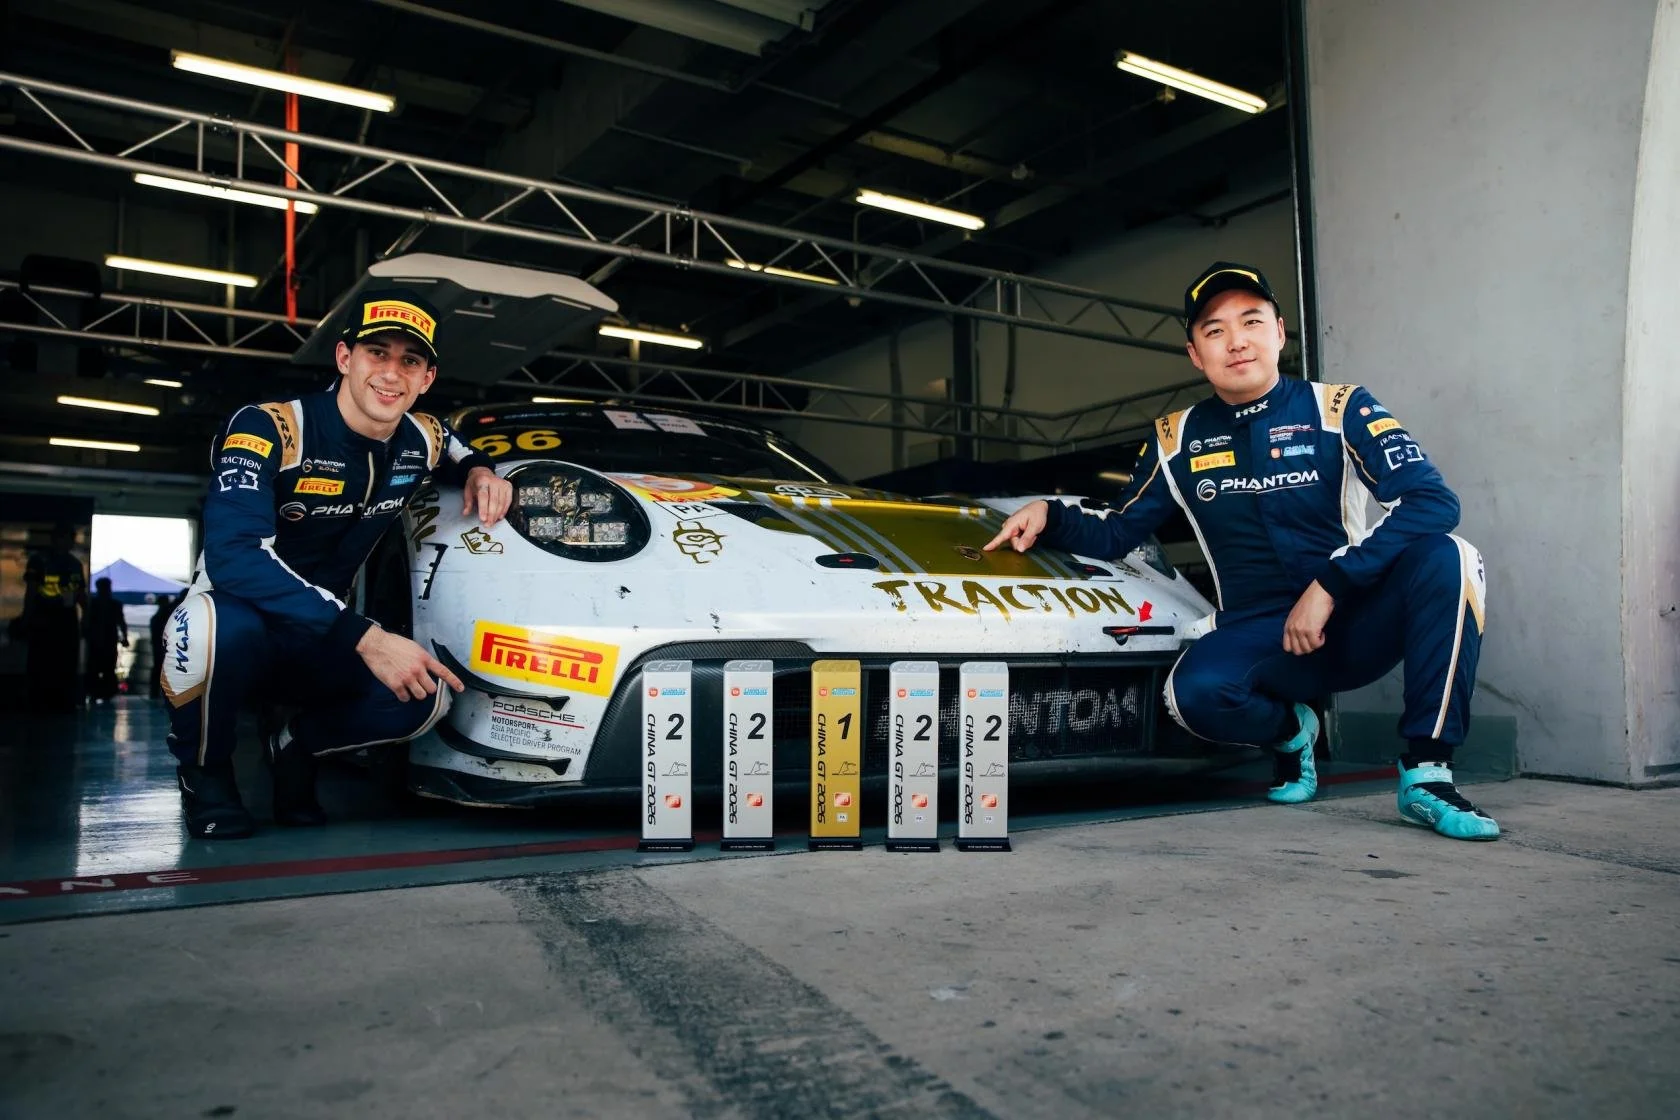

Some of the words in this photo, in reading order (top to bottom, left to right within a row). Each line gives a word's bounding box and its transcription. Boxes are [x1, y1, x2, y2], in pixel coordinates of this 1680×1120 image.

[370, 304, 431, 334] PIRELLI
[1235, 400, 1269, 418] HRX
[225, 437, 267, 452] PIRELLI
[314, 459, 345, 468] PHANTOM
[300, 480, 339, 492] PIRELLI
[1220, 470, 1319, 491] PHANTOM
[872, 579, 1136, 624] TRACTION
[480, 632, 603, 683] PIRELLI
[491, 716, 536, 730] MOTORSPORT
[492, 701, 576, 723] PORSCHE
[490, 724, 505, 733] ASIA
[506, 727, 531, 738] PACIFIC
[647, 713, 656, 757] CHINA
[665, 713, 685, 741] 2
[729, 712, 738, 756] CHINA
[747, 712, 767, 740] 2
[817, 713, 826, 757] CHINA
[837, 713, 853, 740] 1
[895, 714, 904, 758] CHINA
[913, 714, 933, 741] 2
[965, 714, 975, 758] CHINA
[983, 714, 1003, 741] 2
[490, 732, 521, 744] SELECTED
[522, 737, 546, 749] DRIVER
[547, 743, 581, 756] PROGRAM
[647, 761, 656, 782] GT
[729, 761, 738, 782] GT
[817, 760, 826, 781] GT
[894, 761, 904, 782] GT
[965, 761, 974, 782] GT
[647, 784, 656, 825] 2026
[729, 783, 738, 825] 2026
[817, 783, 826, 825] 2026
[894, 784, 904, 826] 2026
[965, 784, 974, 826] 2026
